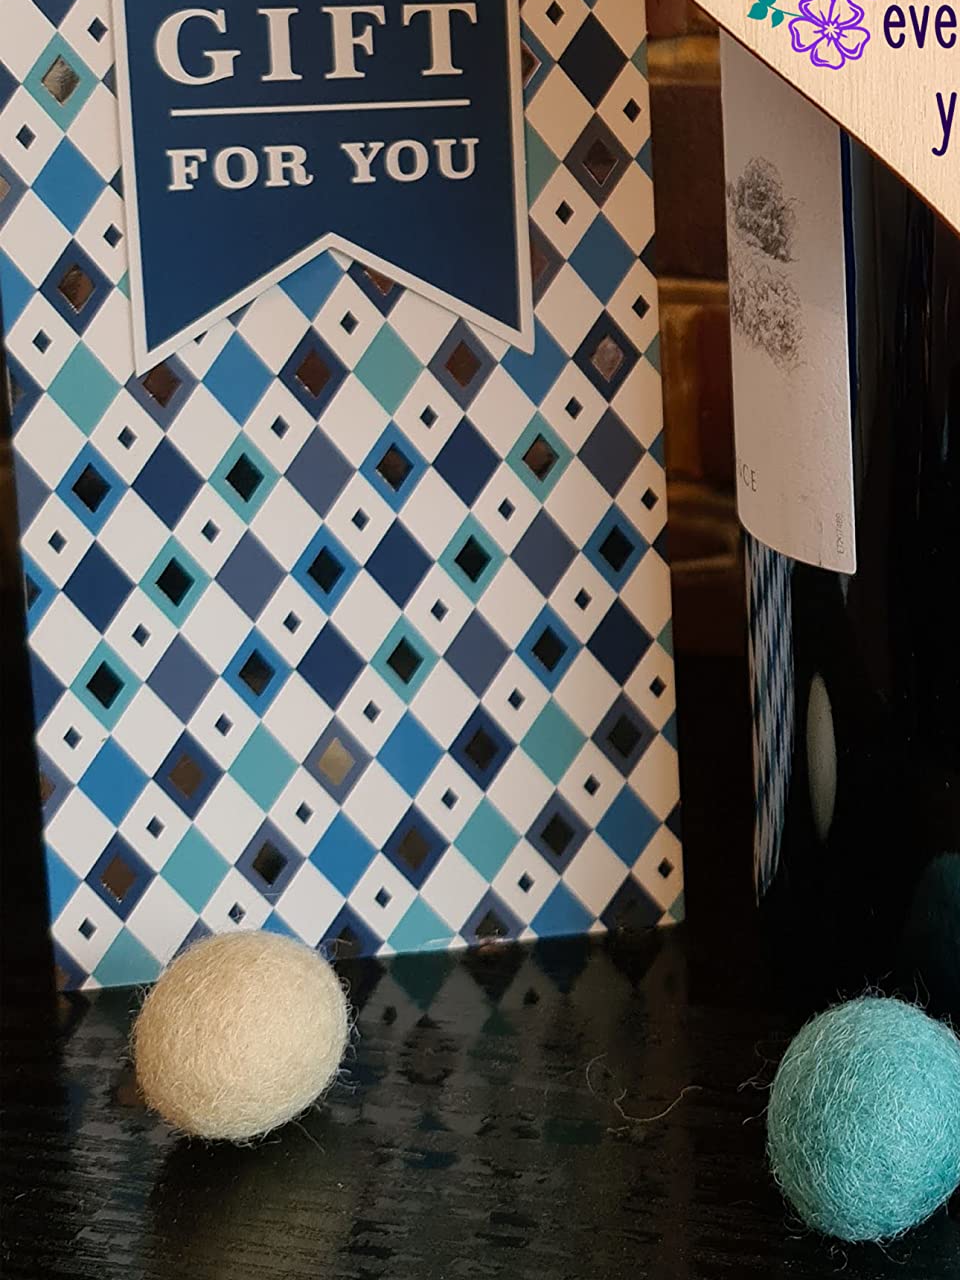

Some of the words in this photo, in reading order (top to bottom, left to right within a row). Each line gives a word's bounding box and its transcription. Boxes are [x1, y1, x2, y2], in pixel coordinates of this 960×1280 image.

[154, 2, 478, 86] GIFT
[165, 145, 314, 192] FOR
[340, 137, 480, 184] YOU
